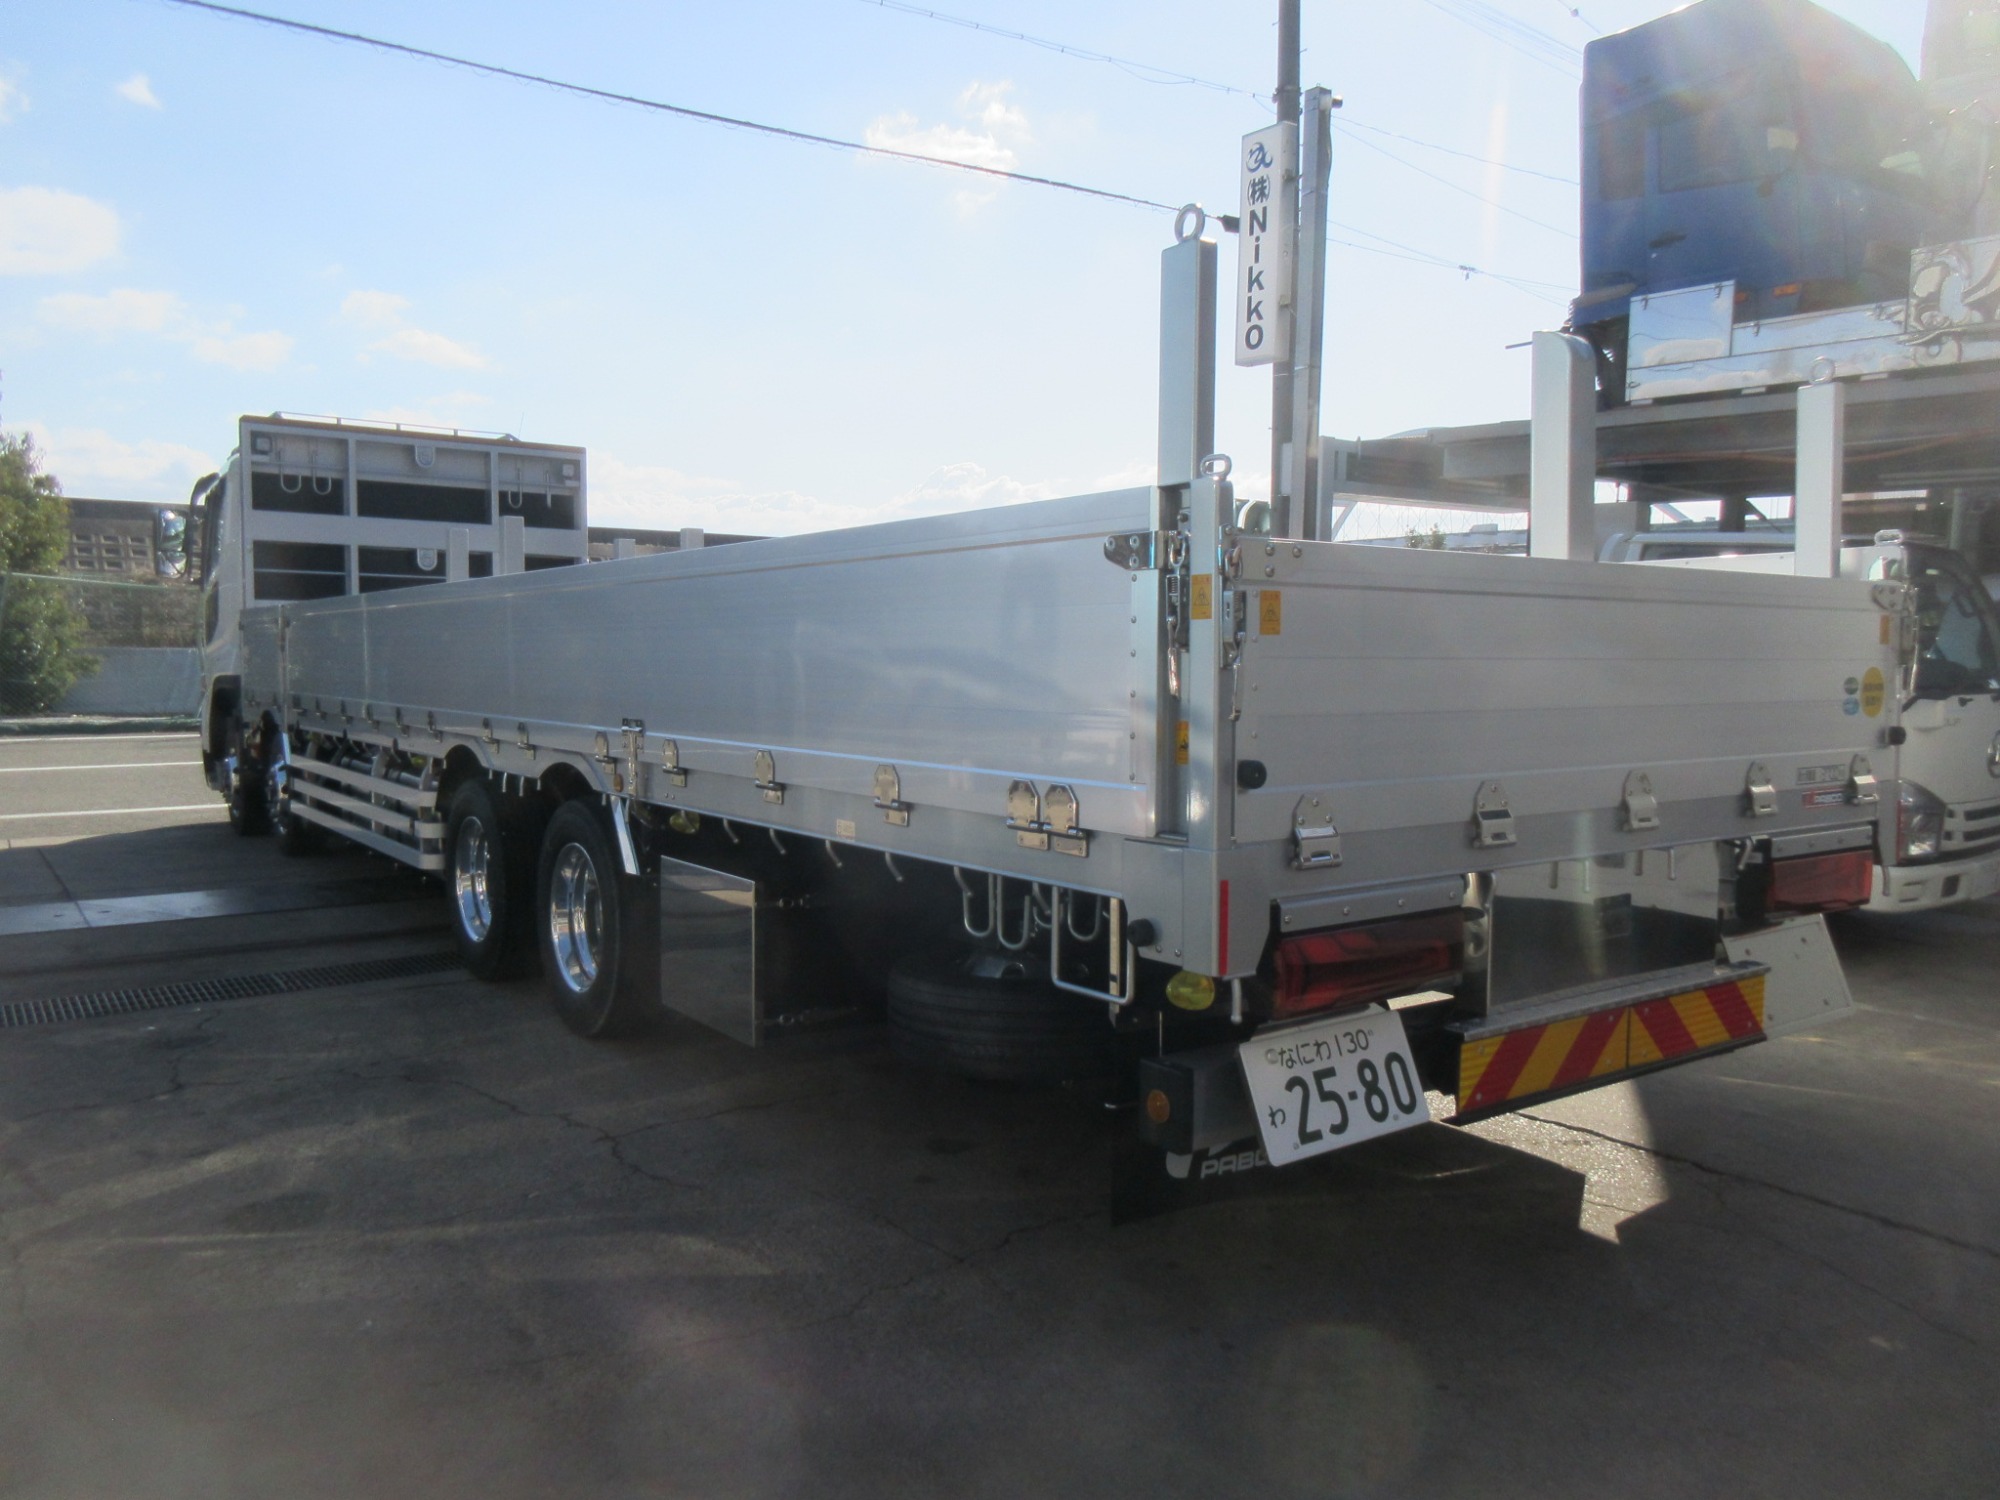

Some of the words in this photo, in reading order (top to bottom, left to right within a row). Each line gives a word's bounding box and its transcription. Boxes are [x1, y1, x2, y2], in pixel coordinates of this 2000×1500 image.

[1334, 1029, 1370, 1057] 130
[1268, 1105, 1286, 1128] わ
[1284, 1051, 1417, 1145] 25-80
[1200, 1149, 1268, 1179] PABC
